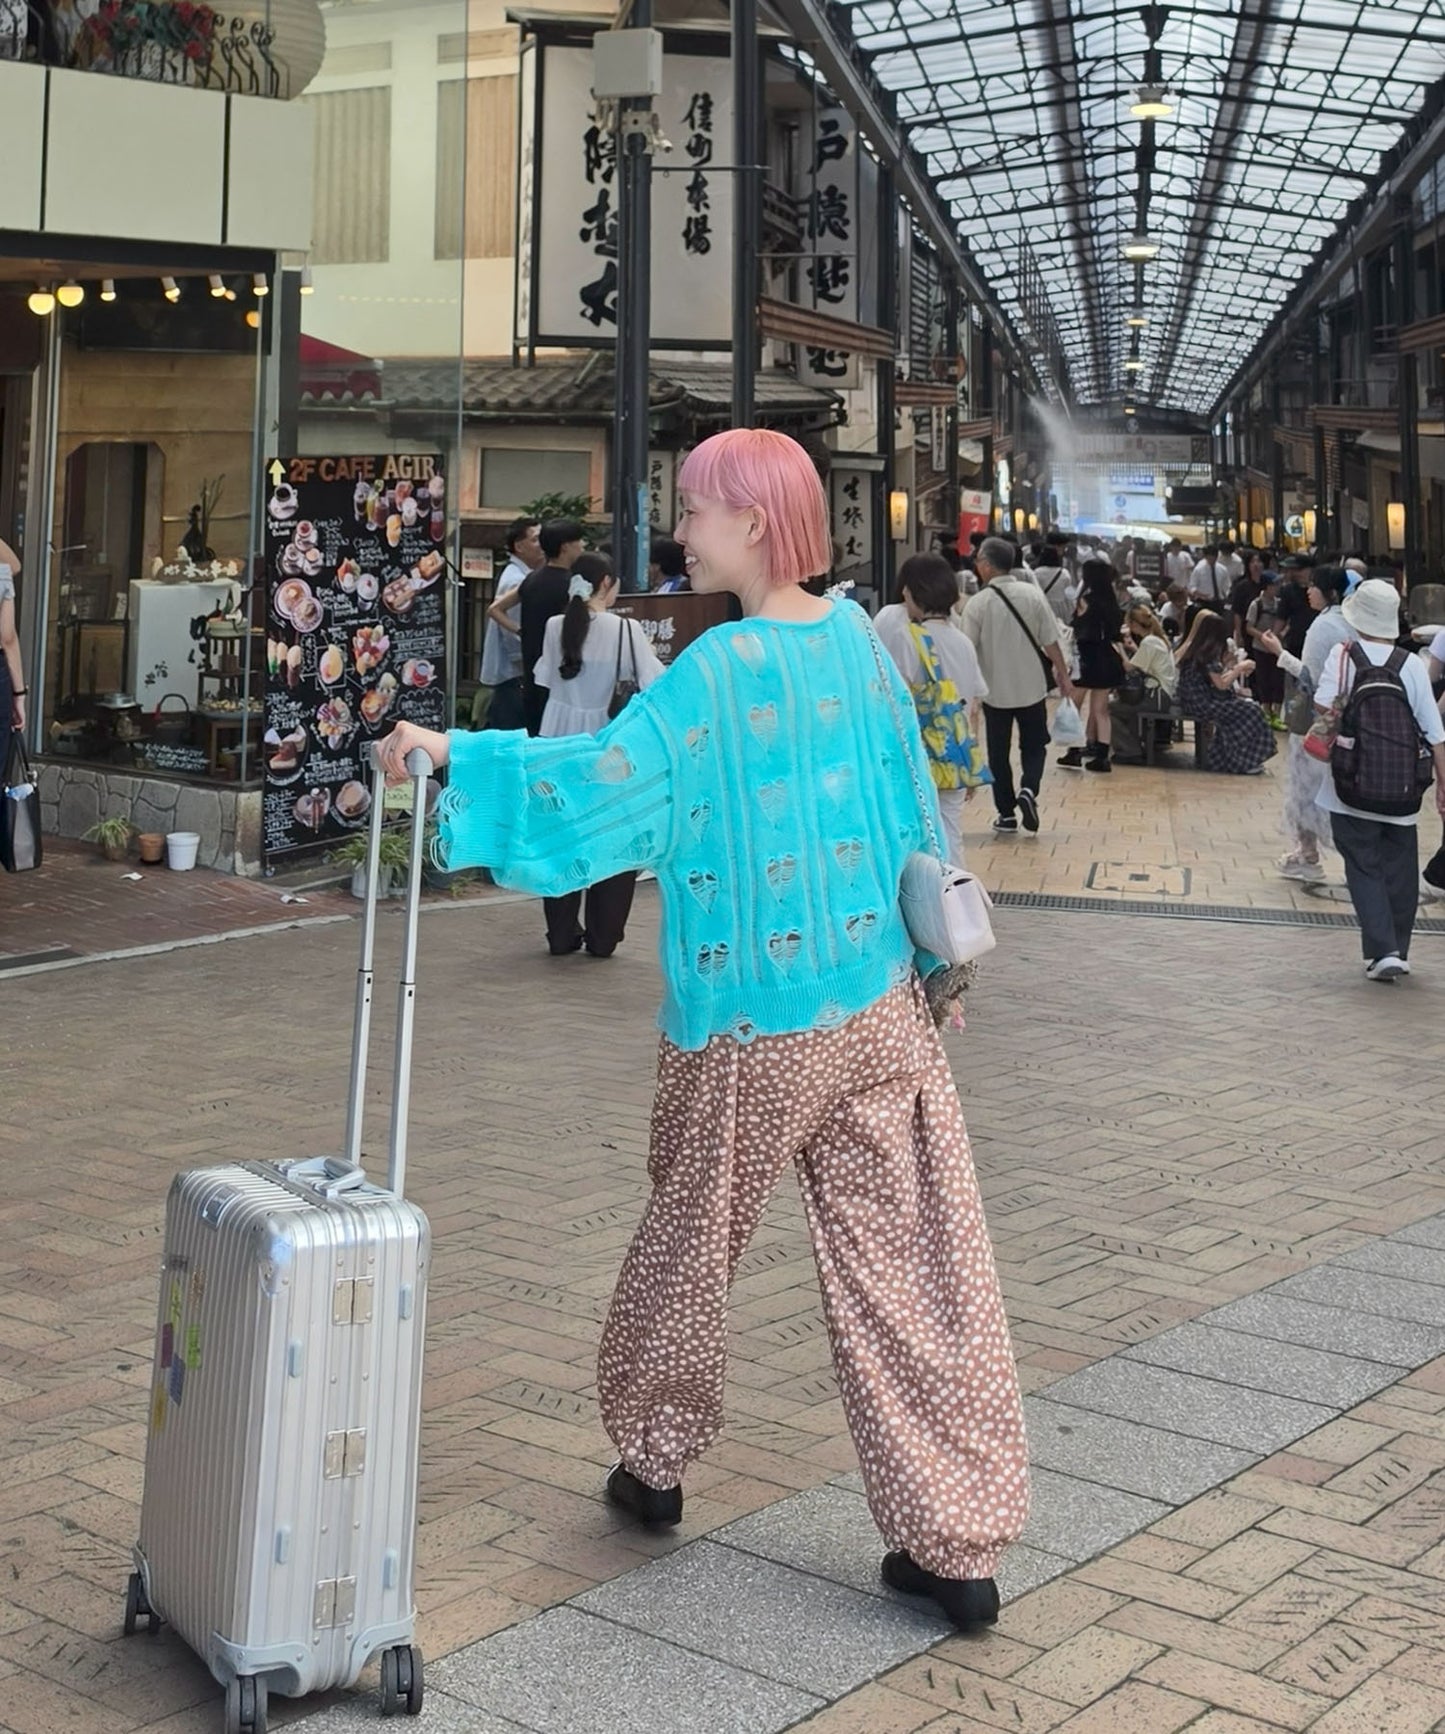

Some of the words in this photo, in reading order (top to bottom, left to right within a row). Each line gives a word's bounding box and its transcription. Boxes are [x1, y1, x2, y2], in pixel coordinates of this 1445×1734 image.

[289, 458, 317, 483] 2F
[319, 456, 376, 482] CAFE
[383, 455, 436, 480] AGIR
